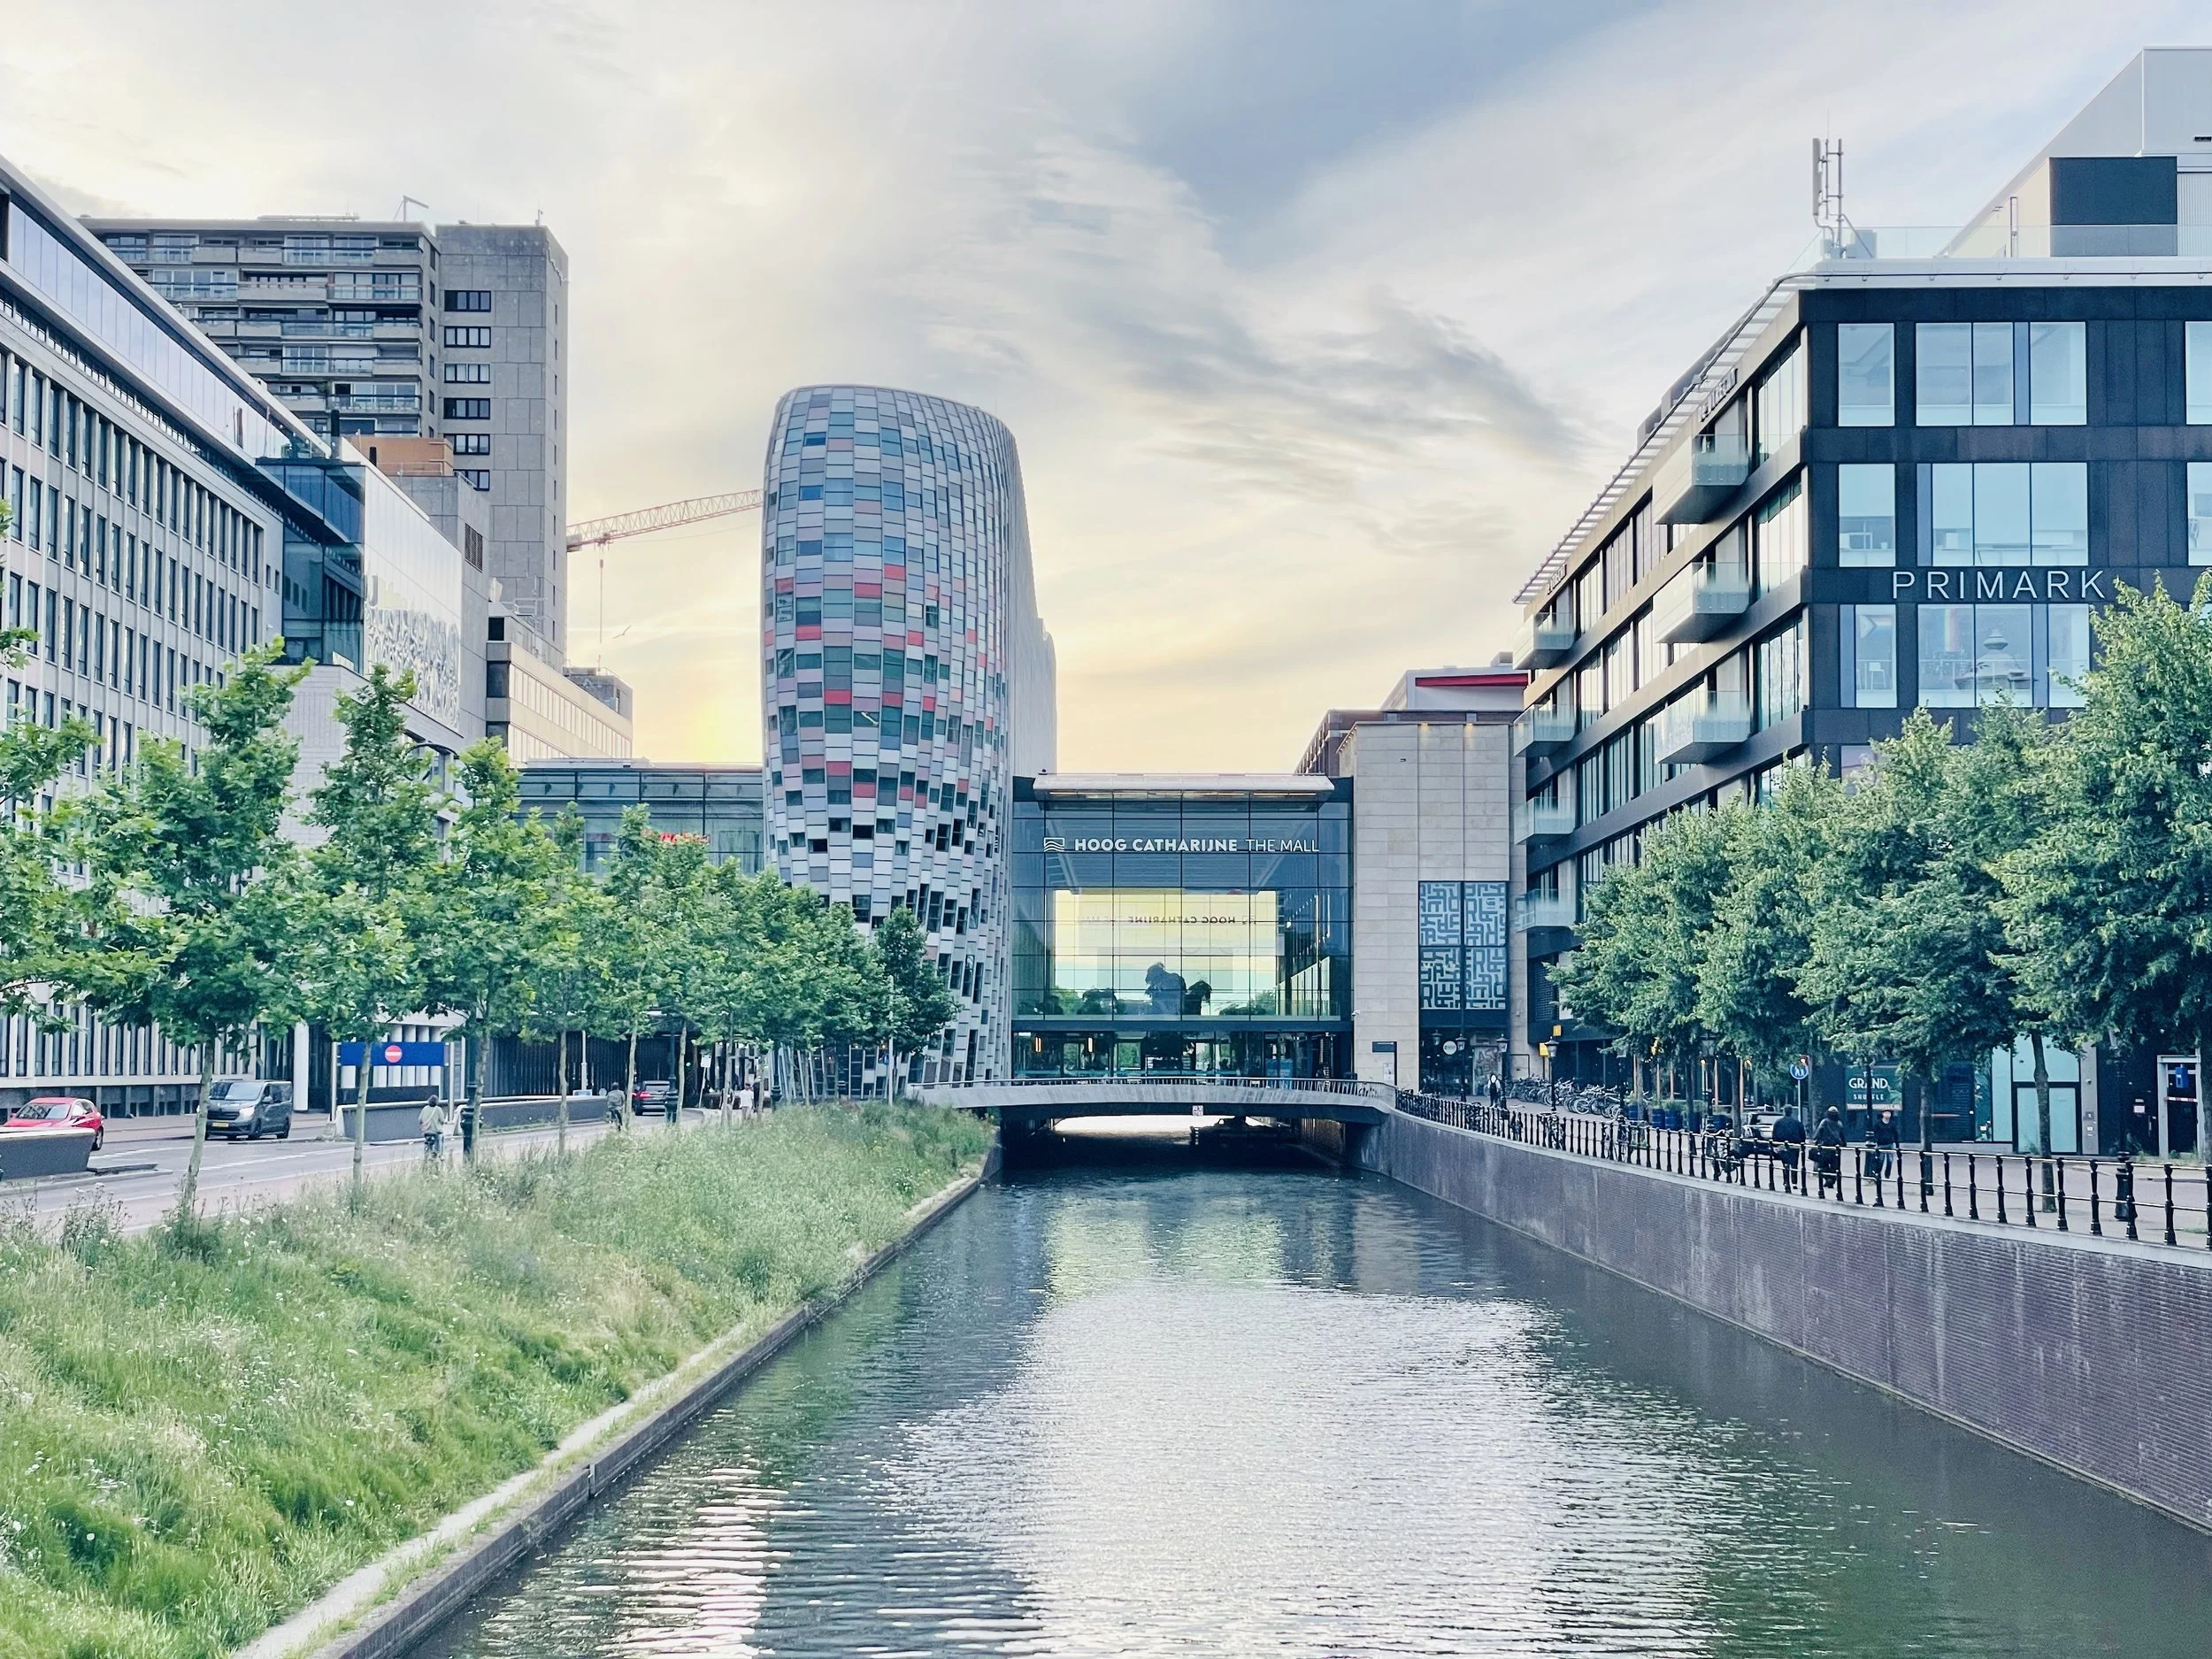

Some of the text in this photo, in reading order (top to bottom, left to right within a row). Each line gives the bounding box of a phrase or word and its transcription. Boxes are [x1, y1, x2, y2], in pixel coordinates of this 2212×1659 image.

[1893, 570, 2106, 599] PRIMARK
[1074, 838, 1319, 852] HOOG CATHARIJNE THE MALL
